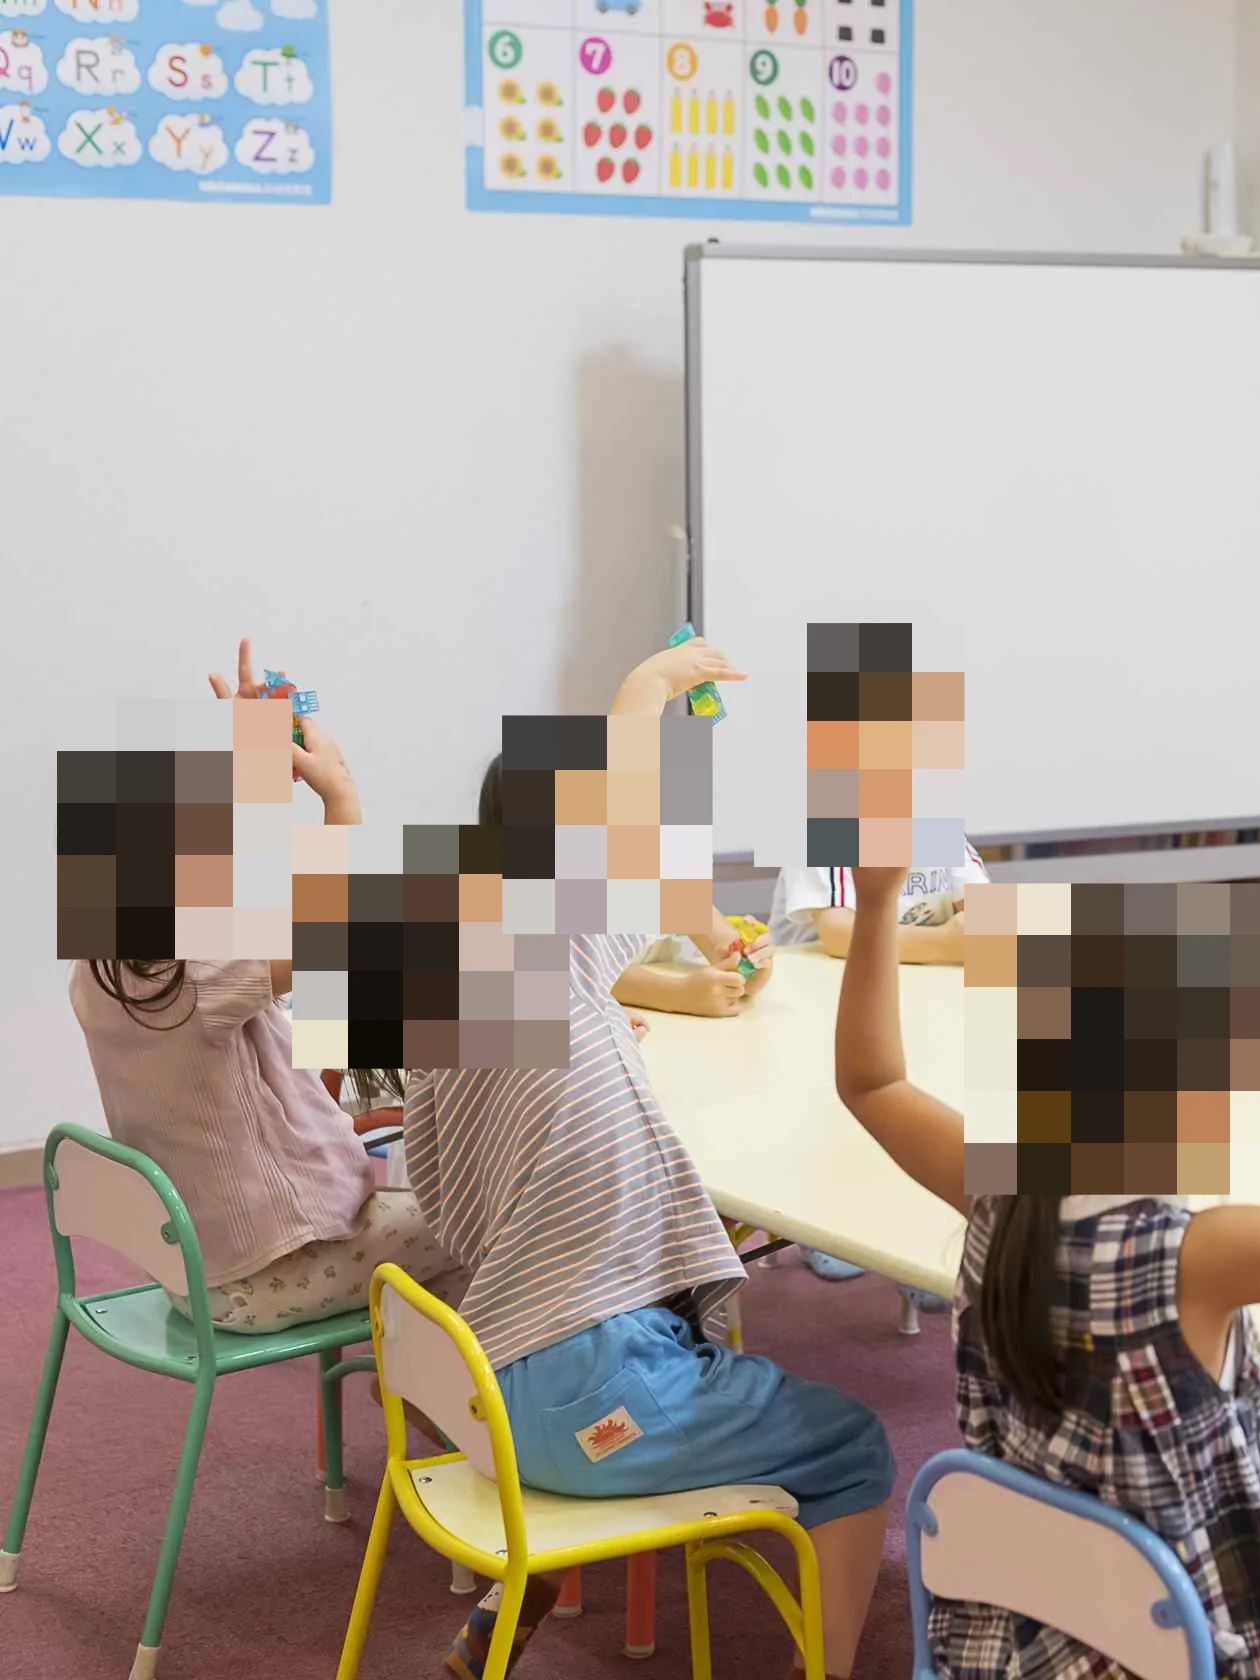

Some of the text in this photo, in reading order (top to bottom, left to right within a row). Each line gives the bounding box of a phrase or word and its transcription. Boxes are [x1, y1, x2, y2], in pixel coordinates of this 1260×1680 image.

[494, 34, 516, 65] 6
[583, 40, 608, 71] 7
[671, 47, 693, 75] 8
[755, 54, 775, 81] 9
[831, 60, 856, 88] 10
